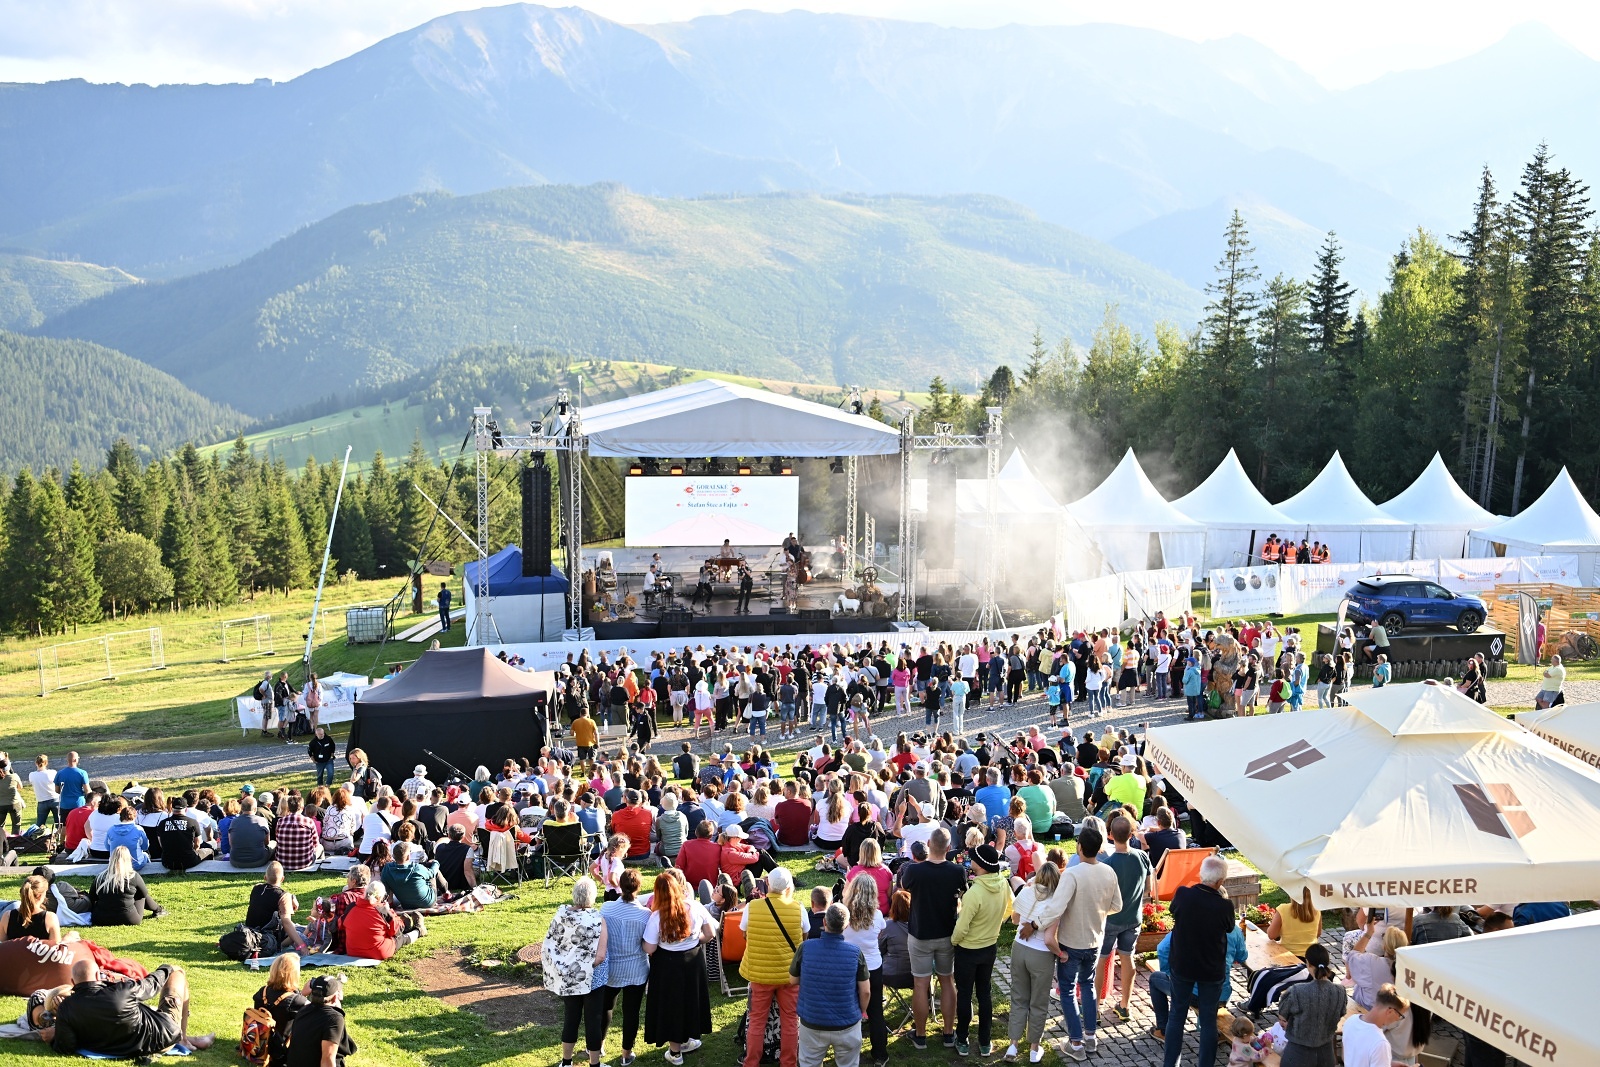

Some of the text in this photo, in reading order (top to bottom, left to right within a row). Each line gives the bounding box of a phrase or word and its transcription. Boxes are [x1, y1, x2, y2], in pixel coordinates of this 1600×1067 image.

[1150, 744, 1195, 794] KALTENECKER
[1342, 878, 1478, 899] KALTENECKER
[1422, 977, 1558, 1062] KALTENECKER
